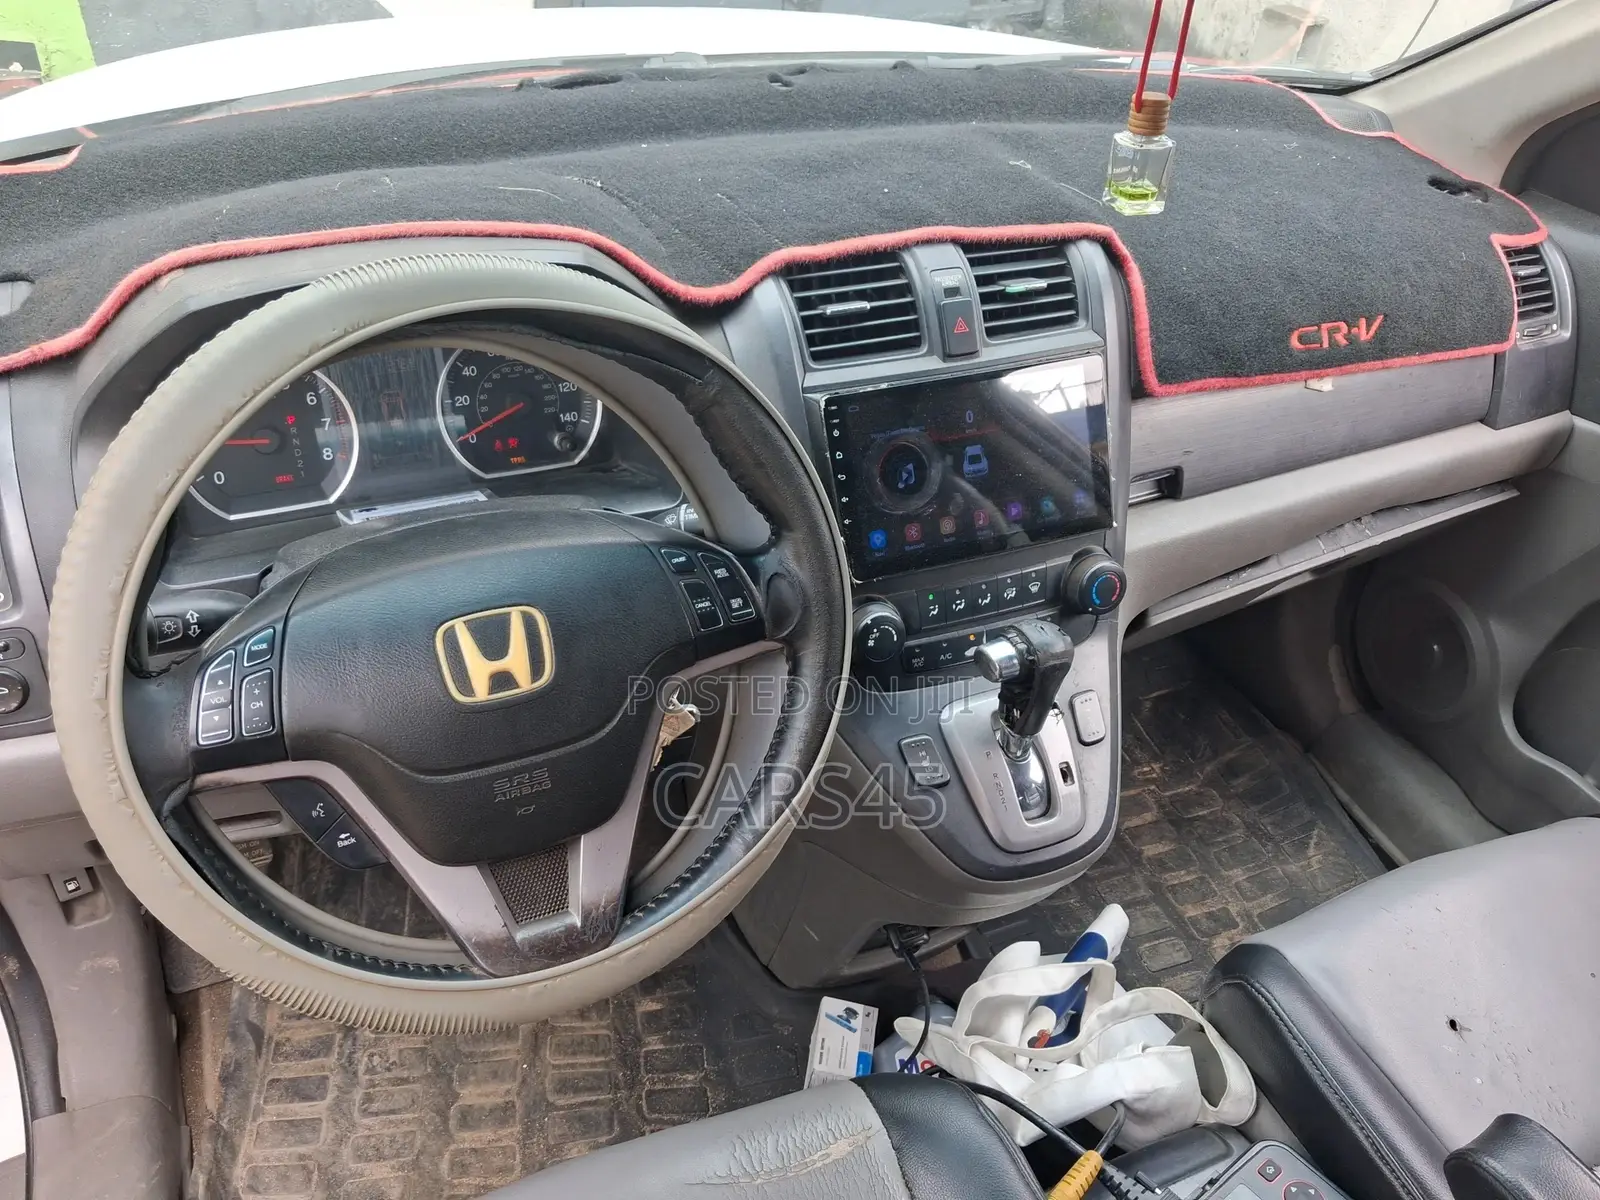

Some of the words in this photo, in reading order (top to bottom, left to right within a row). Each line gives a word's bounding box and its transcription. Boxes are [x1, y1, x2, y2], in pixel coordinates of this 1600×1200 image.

[462, 366, 477, 377] 40
[558, 382, 578, 393] 120
[306, 392, 317, 405] 6
[455, 395, 470, 406] 20
[559, 411, 578, 423] 140
[320, 417, 331, 431] 7
[468, 433, 477, 444] 0
[294, 448, 302, 457] D
[322, 447, 334, 461] 8
[297, 460, 304, 468] 2
[213, 471, 225, 485] 0
[694, 601, 712, 609] CANCEL
[869, 632, 880, 640] OFF
[250, 643, 268, 651] MODE
[939, 652, 952, 660] A/C
[210, 696, 227, 705] VOL
[250, 701, 264, 709] CH
[493, 767, 549, 791] SRS
[494, 780, 552, 803] AIRBAG
[337, 837, 357, 848] Back
